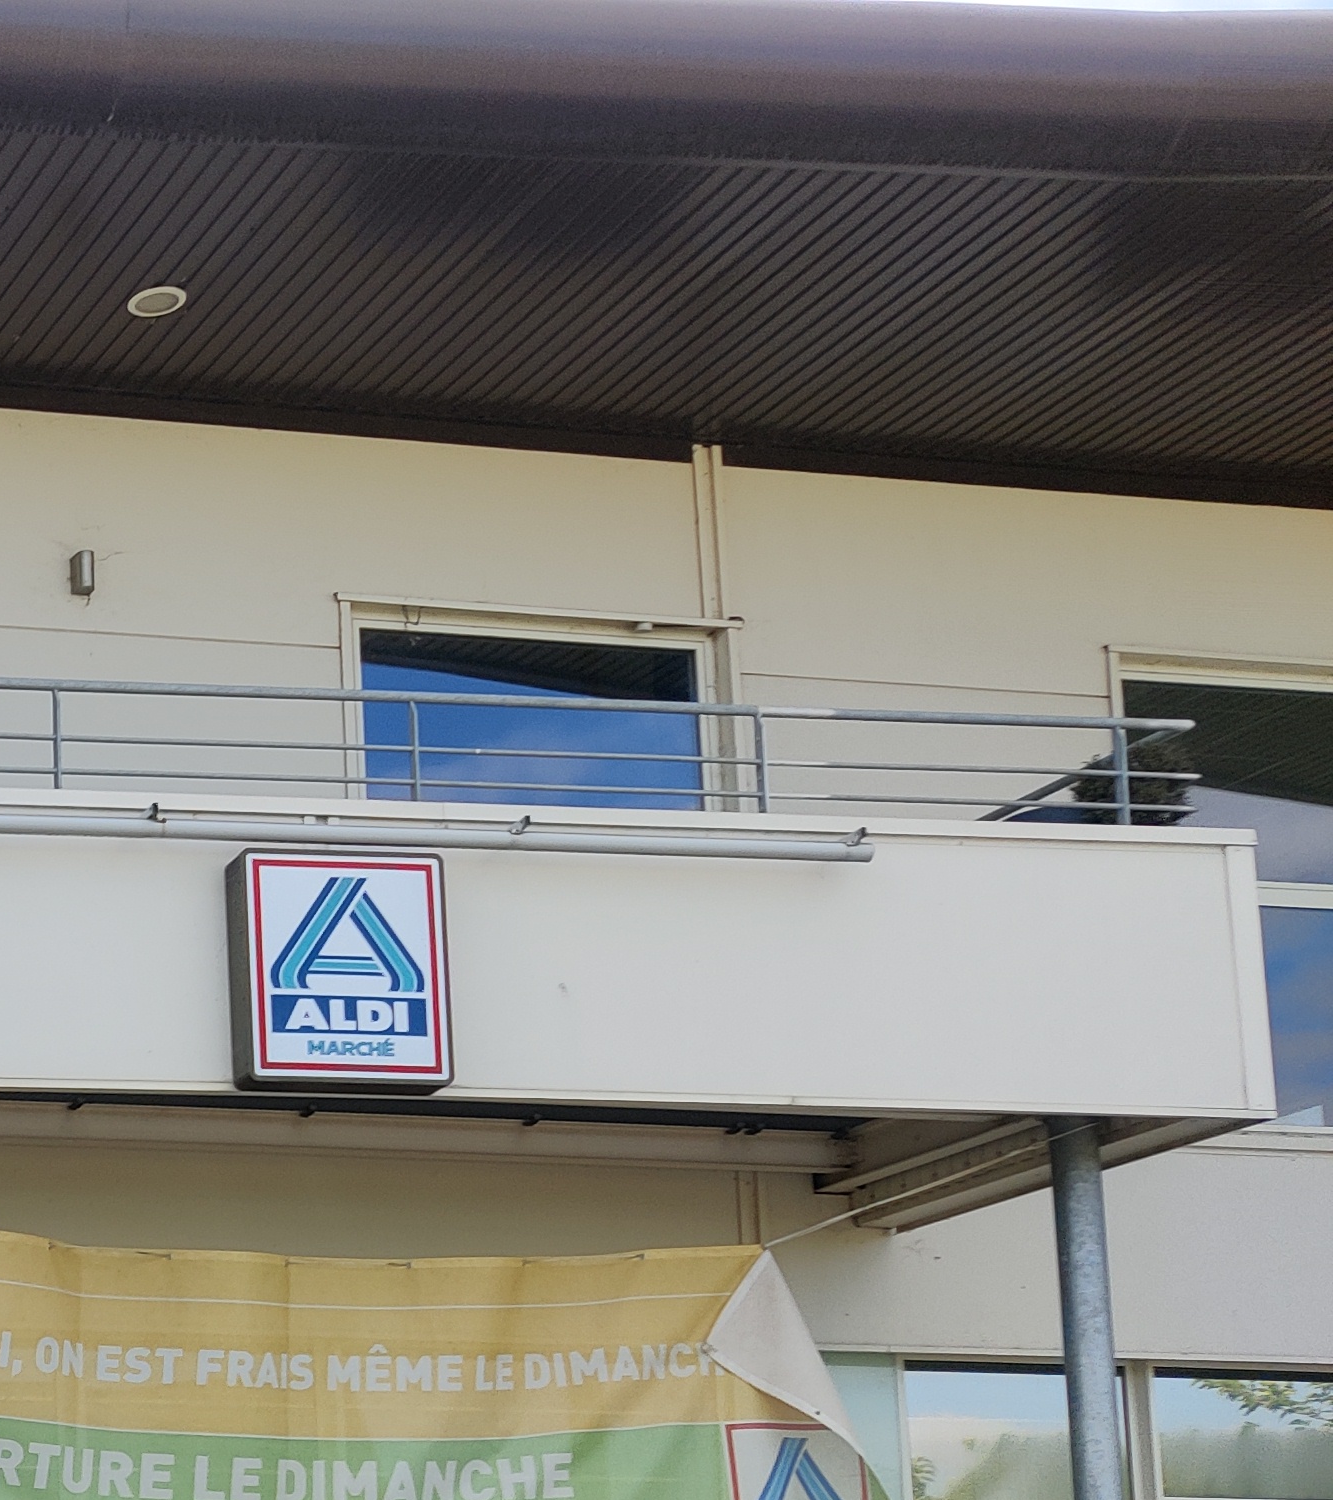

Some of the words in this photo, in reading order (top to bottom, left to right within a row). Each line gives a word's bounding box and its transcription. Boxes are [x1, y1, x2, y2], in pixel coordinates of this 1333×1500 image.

[284, 997, 411, 1033] ALDI
[306, 1037, 396, 1057] MARCHÉ
[35, 1336, 84, 1379] ON
[96, 1345, 184, 1385] EST
[195, 1348, 314, 1391] FRAIS
[326, 1343, 464, 1393] MÊME
[474, 1353, 514, 1392] LE
[523, 1342, 725, 1391] DIMANCH
